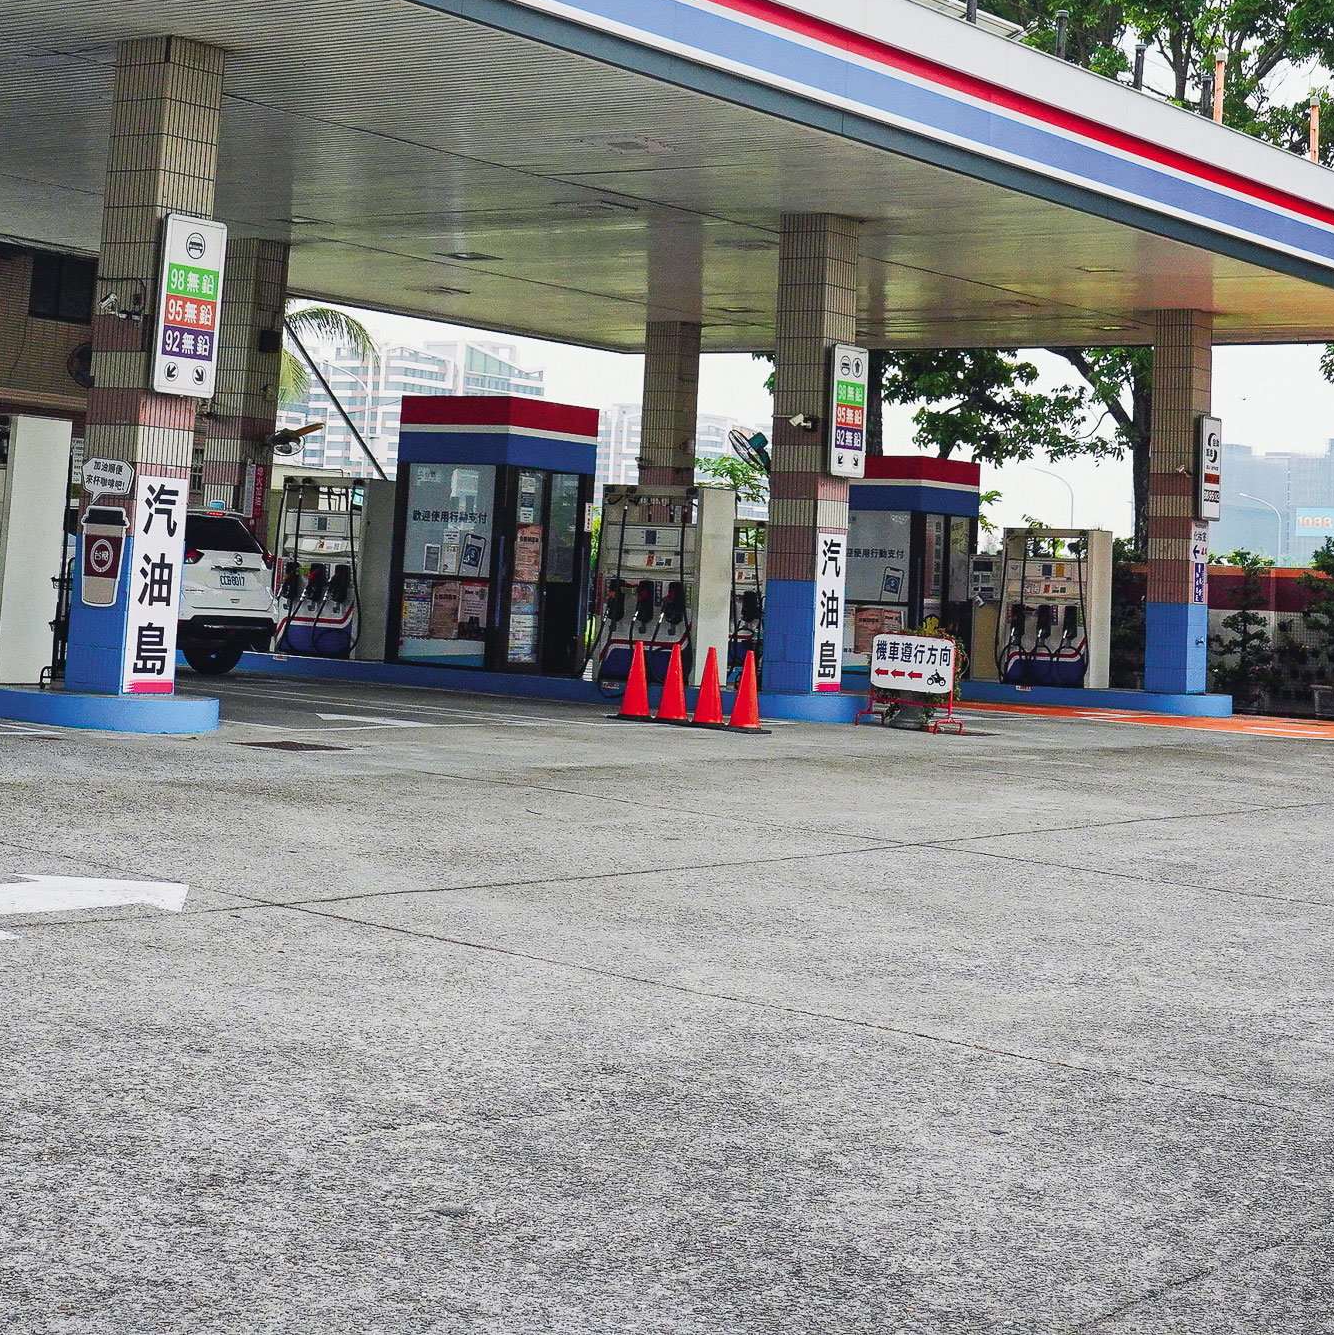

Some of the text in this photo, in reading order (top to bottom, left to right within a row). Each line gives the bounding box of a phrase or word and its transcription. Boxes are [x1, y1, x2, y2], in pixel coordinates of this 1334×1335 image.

[170, 268, 215, 295] 98無鉛
[167, 298, 213, 326] 95無鉛
[165, 329, 210, 356] 92無鉛
[1297, 515, 1333, 529] 1088
[132, 483, 180, 677] 汽油島
[817, 538, 842, 680] 汽油島
[875, 639, 952, 667] 機車遵行方向
